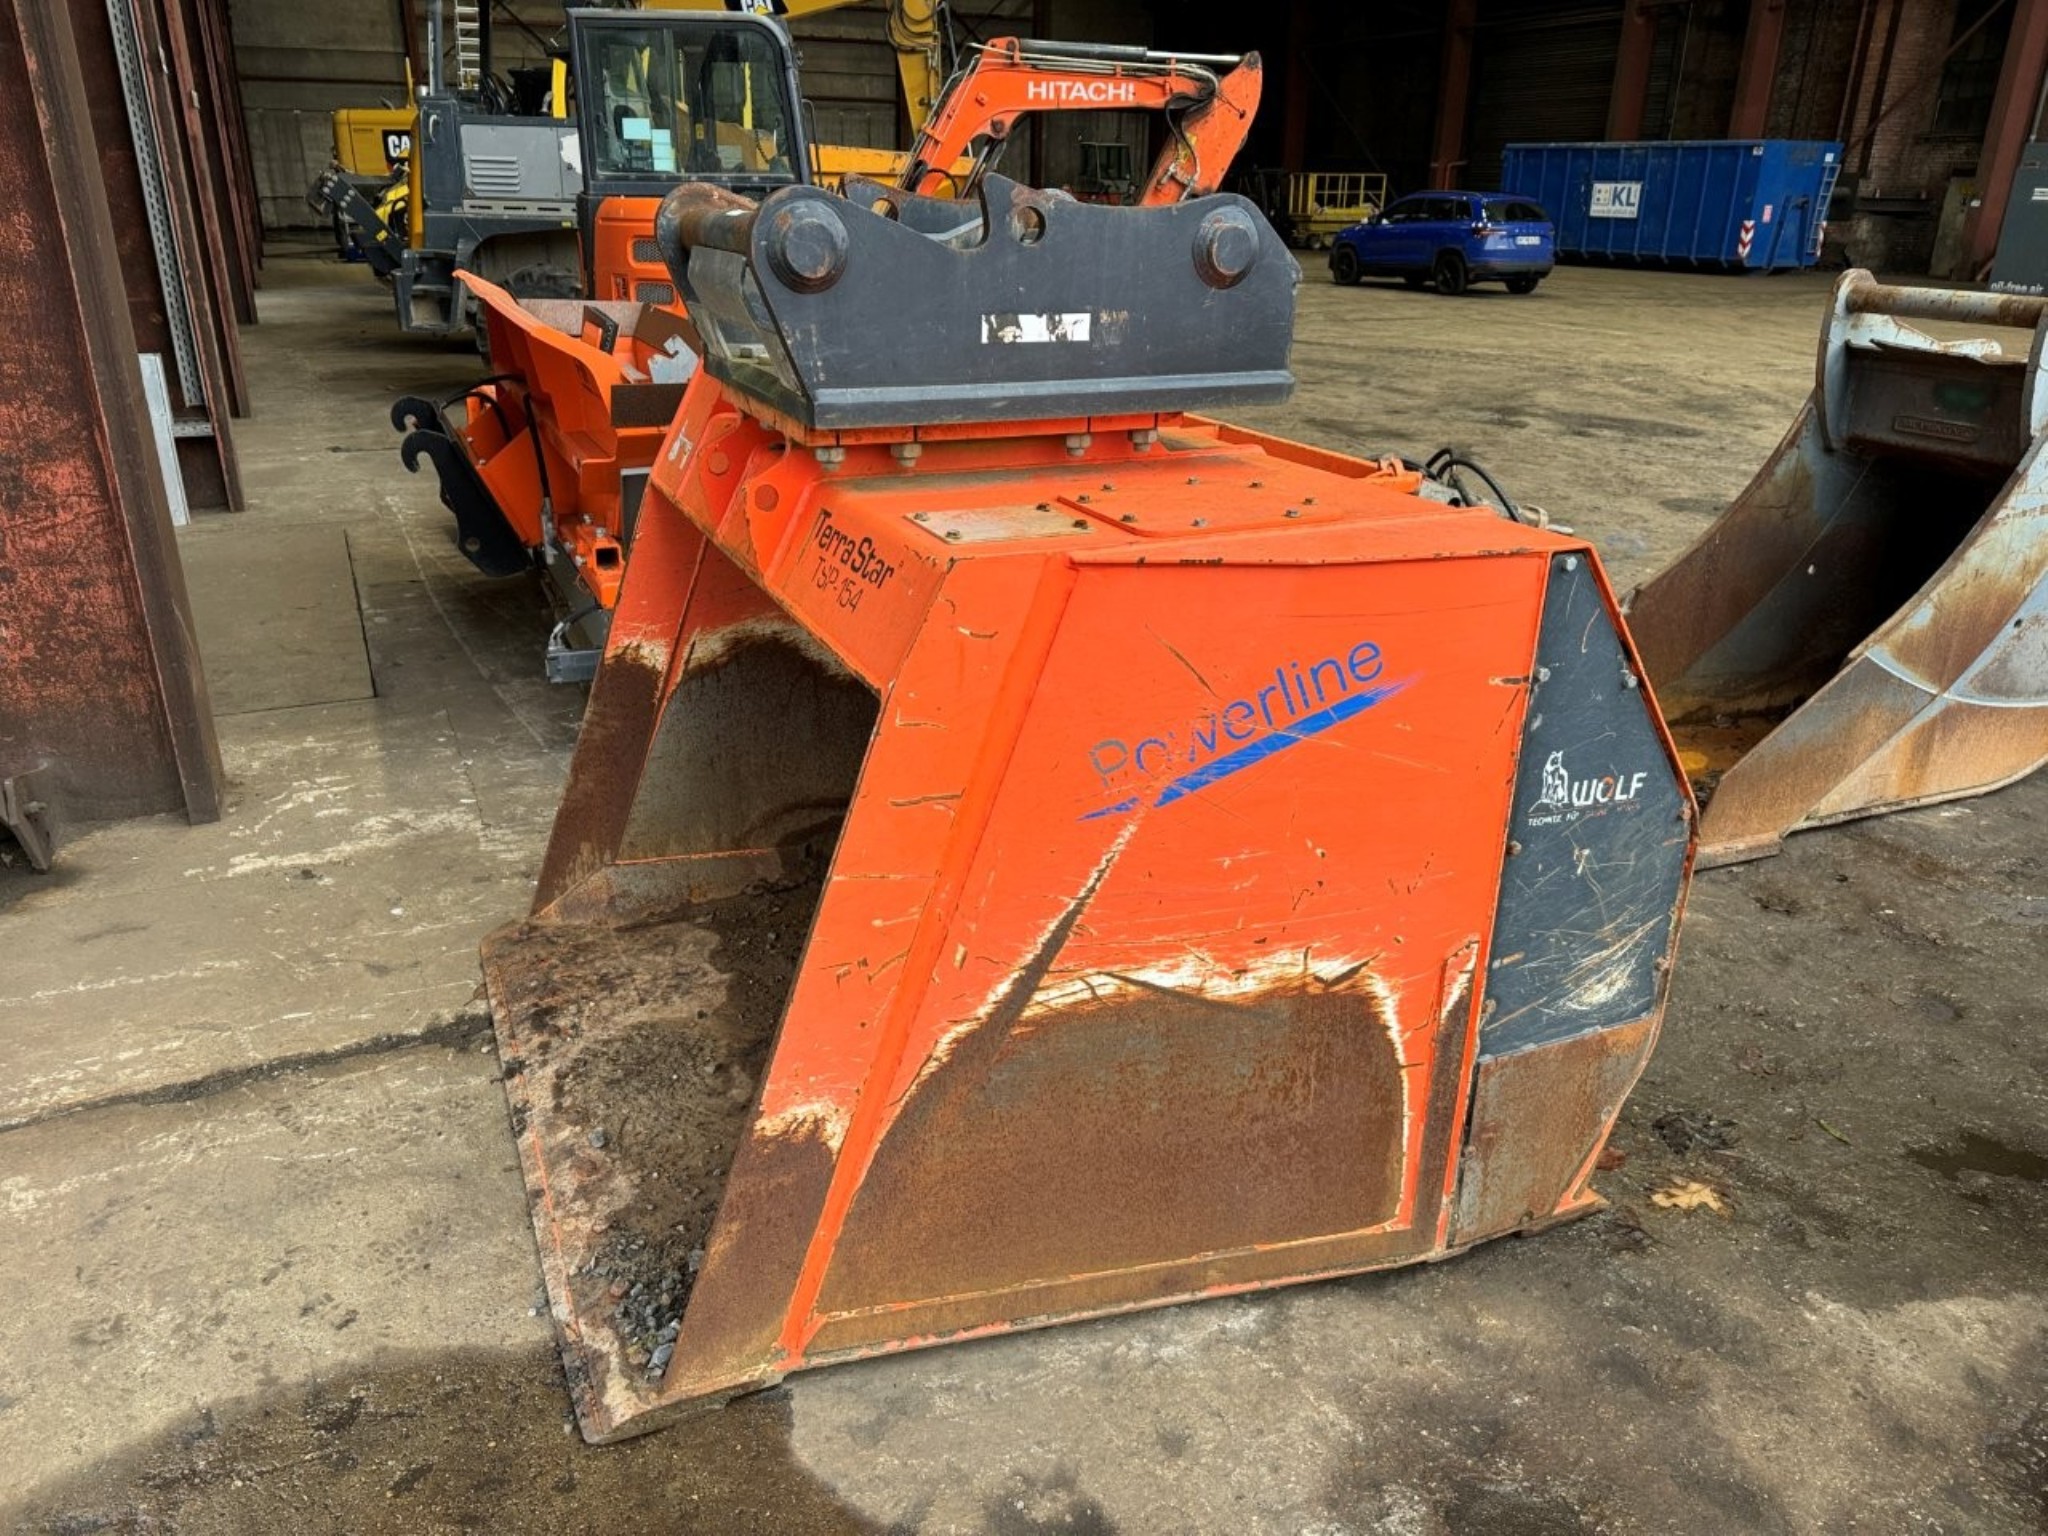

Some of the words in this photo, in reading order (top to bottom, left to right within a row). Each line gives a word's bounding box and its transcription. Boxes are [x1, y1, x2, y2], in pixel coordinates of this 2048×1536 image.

[1027, 80, 1136, 102] HITACHI
[387, 134, 411, 158] CA
[1612, 186, 1636, 207] KL
[815, 508, 895, 589] TerraStar
[1571, 771, 1648, 807] WOLF
